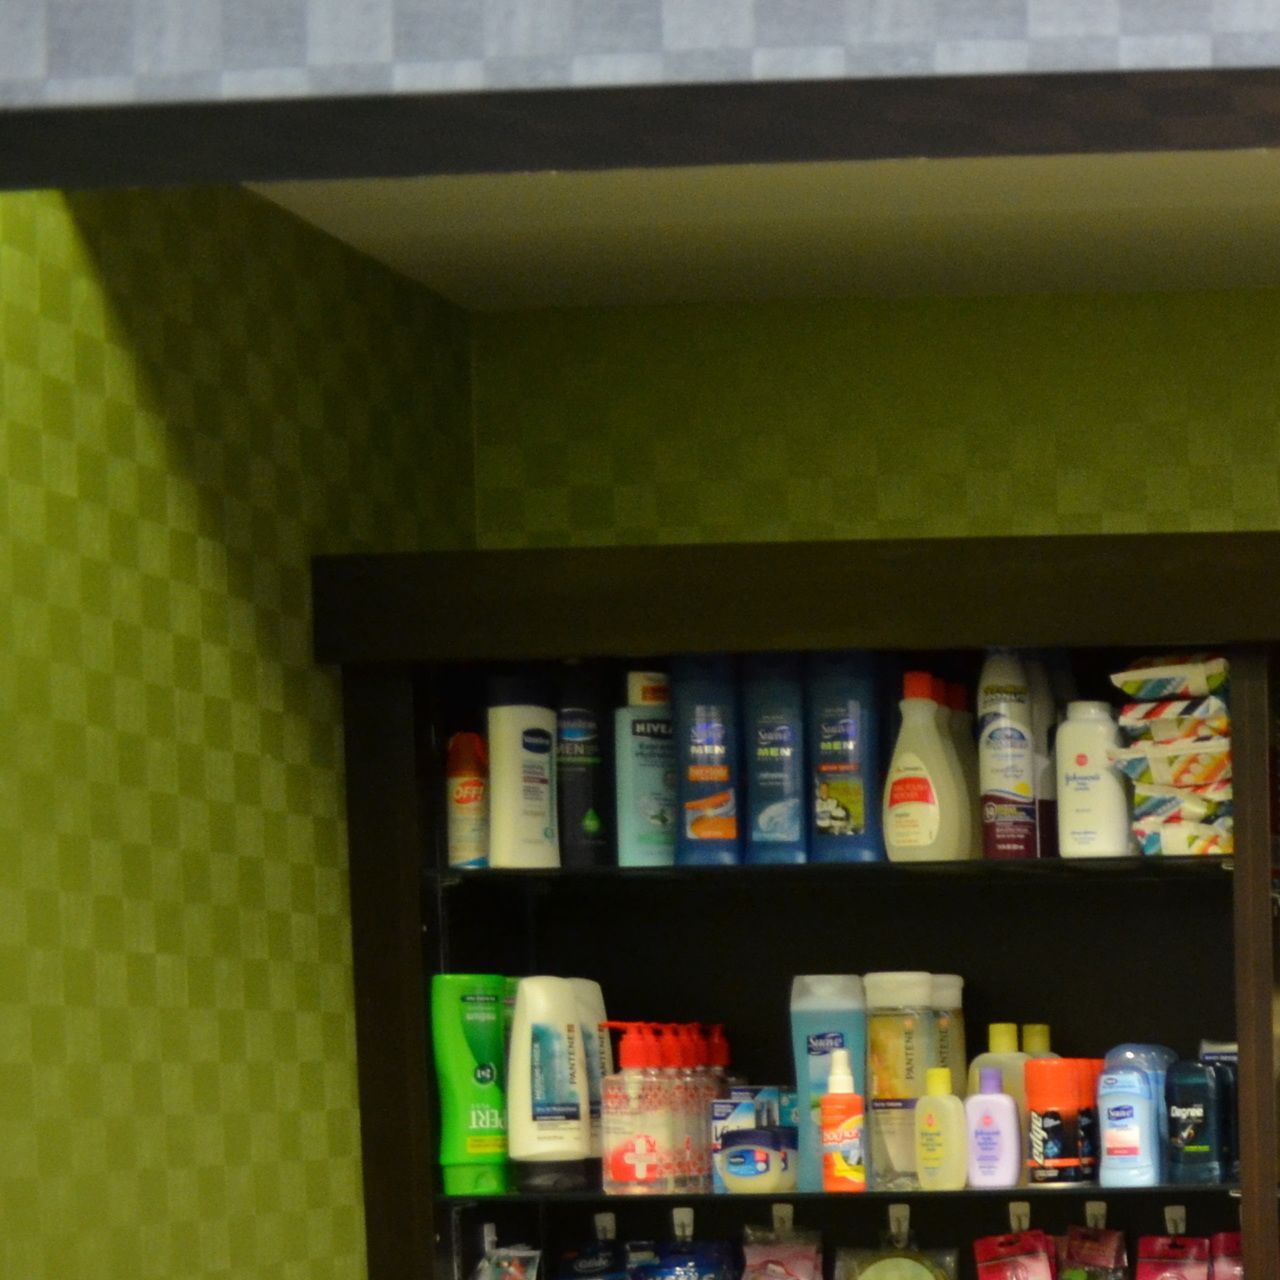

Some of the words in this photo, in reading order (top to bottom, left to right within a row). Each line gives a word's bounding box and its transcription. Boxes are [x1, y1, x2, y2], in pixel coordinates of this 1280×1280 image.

[690, 745, 725, 755] MEN
[757, 747, 791, 758] MEN
[820, 740, 856, 751] MEN
[454, 784, 483, 801] OFF!
[807, 1034, 844, 1053] Suave
[568, 1029, 577, 1084] PANTENE
[904, 1029, 914, 1081] PANTENE
[1170, 1105, 1204, 1120] Degree
[1028, 1111, 1043, 1166] edge
